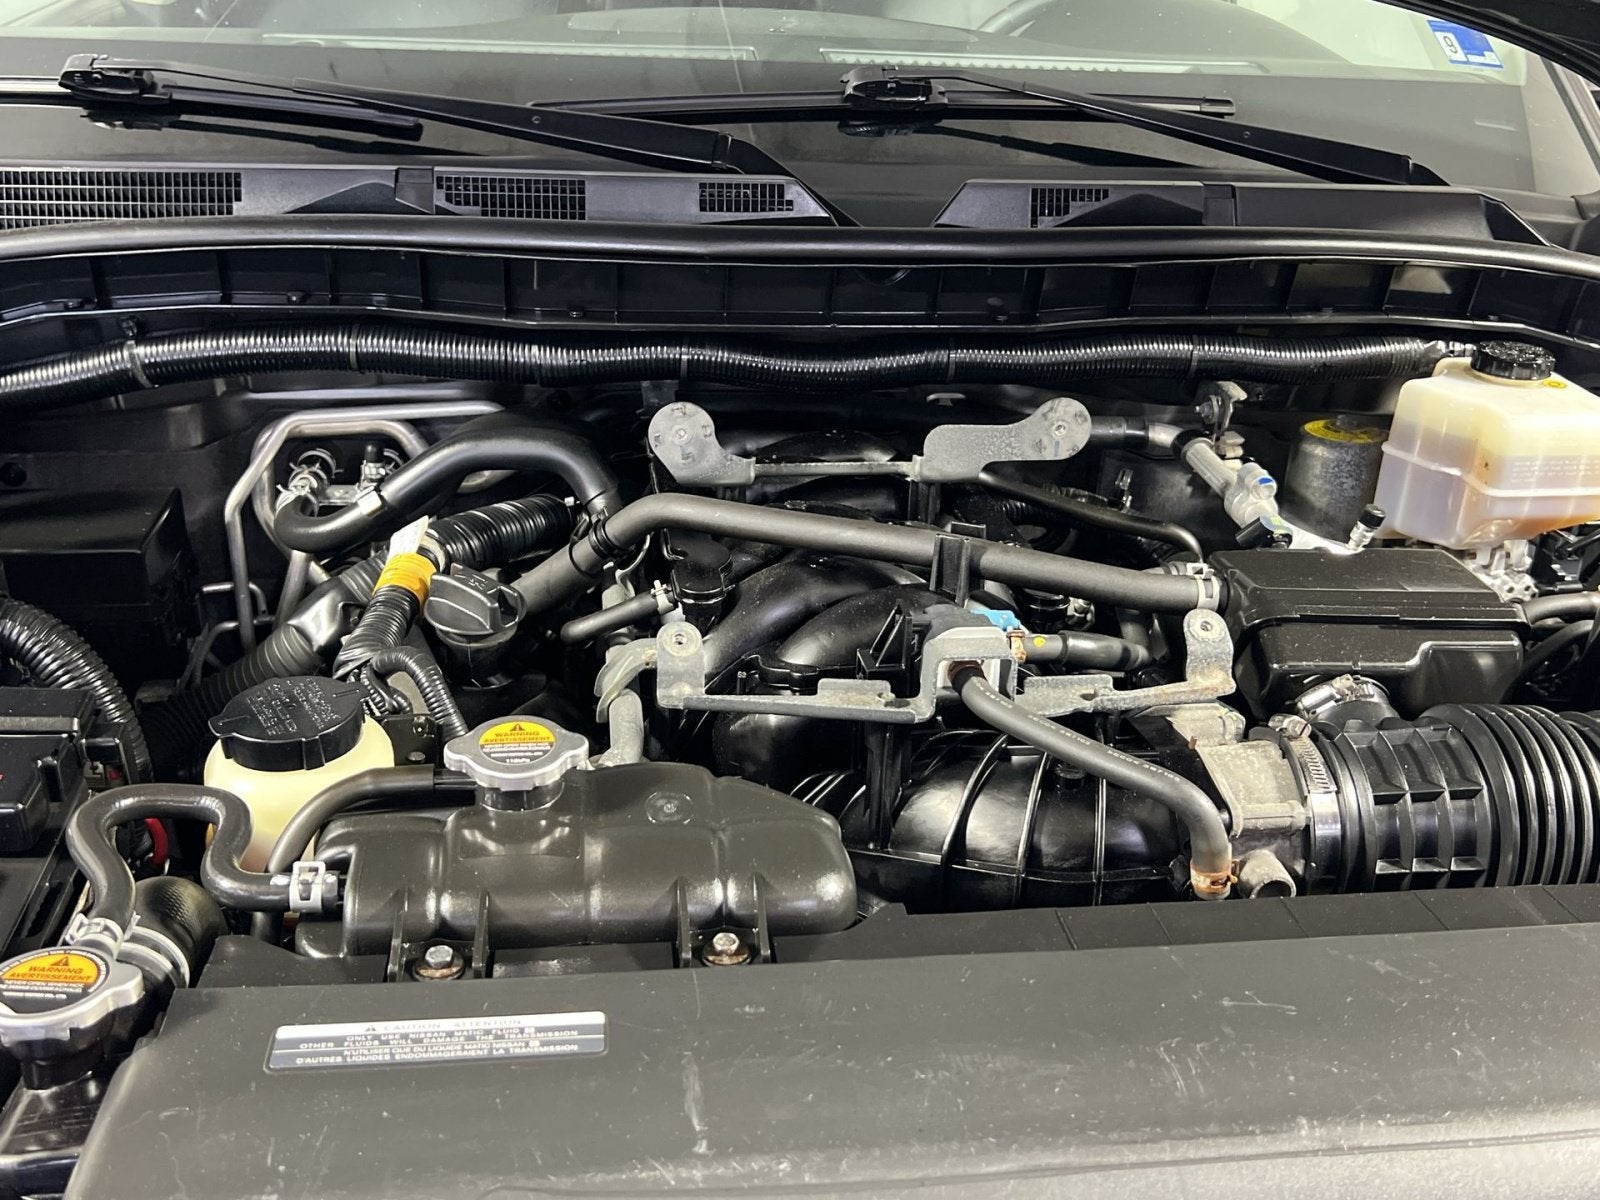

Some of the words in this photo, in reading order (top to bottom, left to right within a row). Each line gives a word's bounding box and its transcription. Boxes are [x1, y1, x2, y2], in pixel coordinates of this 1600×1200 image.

[28, 966, 84, 974] WARNING
[9, 972, 92, 981] AVERTISSEMENT
[384, 1023, 440, 1031] CAUTION
[454, 1019, 521, 1028] ATTENTION
[504, 1030, 578, 1039] TRANSMISSION
[295, 1056, 342, 1065] D'AUTRES
[346, 1054, 391, 1062] LIQUIDES
[509, 1044, 578, 1054] TRANSMISSION
